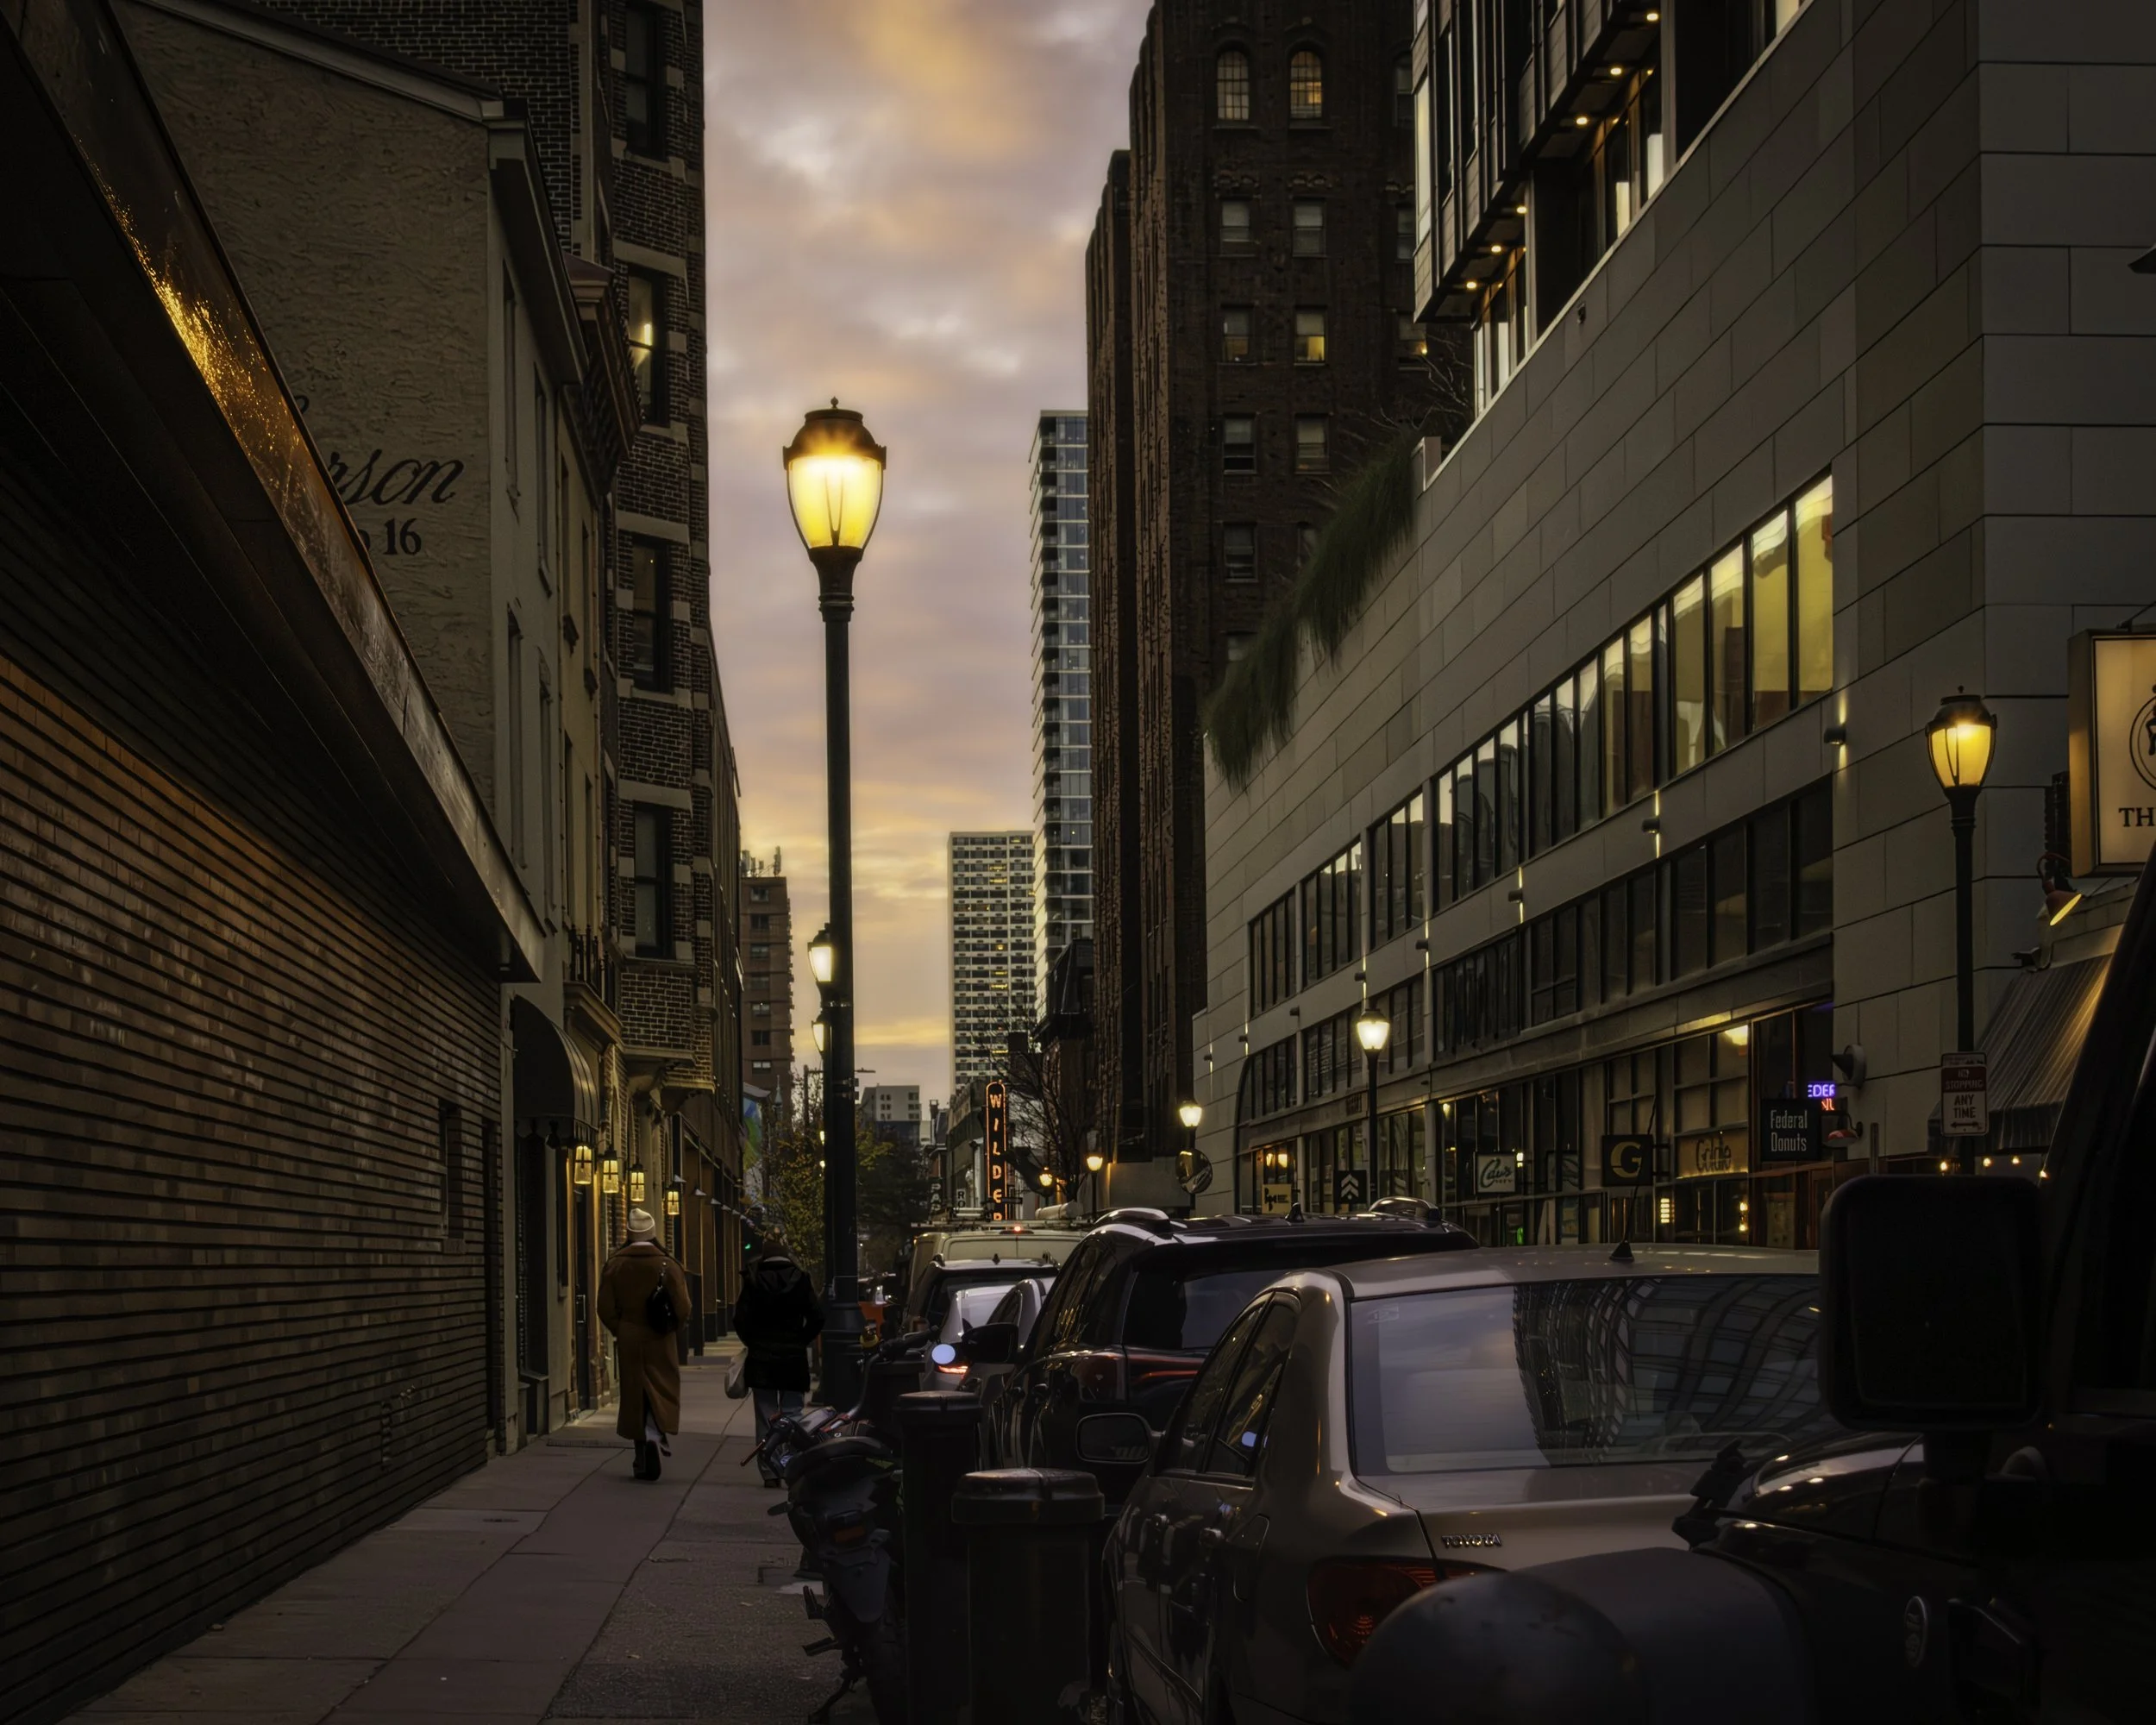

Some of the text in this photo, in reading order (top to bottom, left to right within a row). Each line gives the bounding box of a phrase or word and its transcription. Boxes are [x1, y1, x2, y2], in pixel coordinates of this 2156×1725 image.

[383, 518, 423, 555] 16
[1958, 1069, 1970, 1078] NO
[1945, 1079, 1984, 1091] STOPPING
[1954, 1094, 1975, 1106] ANY
[1770, 1109, 1808, 1129] Federal
[1953, 1107, 1976, 1119] TIME
[1771, 1132, 1808, 1152] Donuts
[1610, 1140, 1643, 1178] G
[1441, 1533, 1502, 1548] TOYOTA
